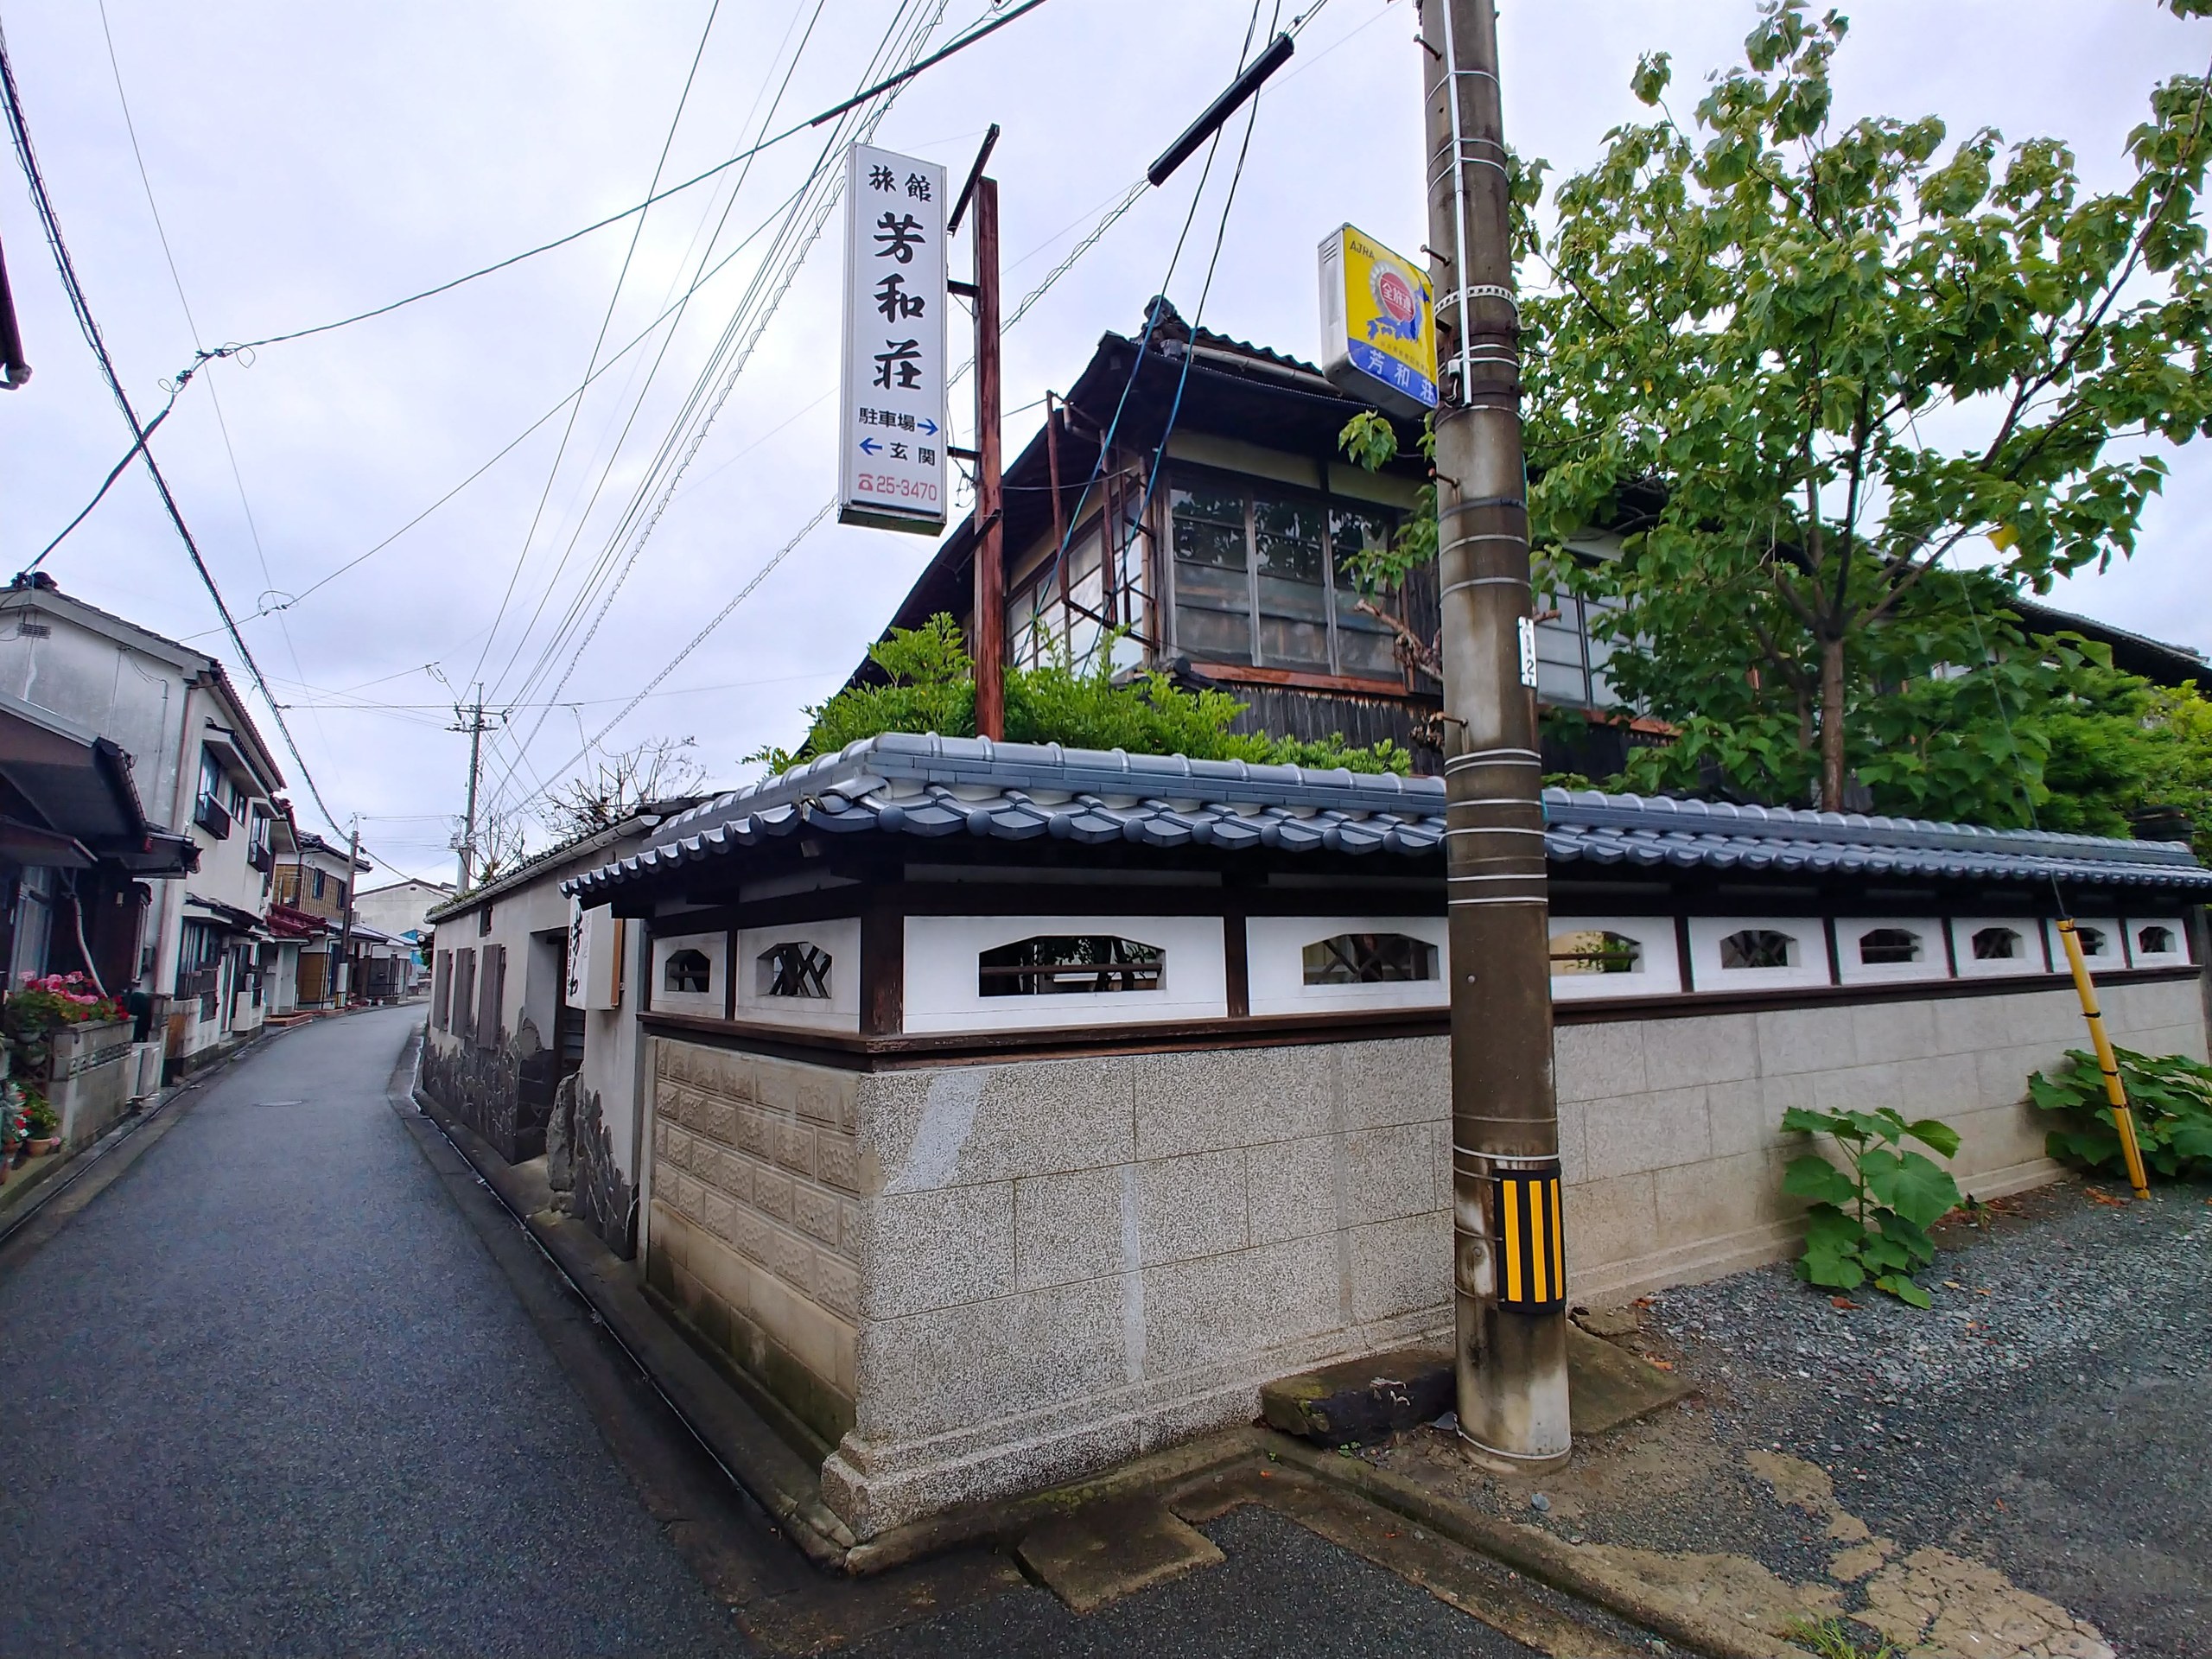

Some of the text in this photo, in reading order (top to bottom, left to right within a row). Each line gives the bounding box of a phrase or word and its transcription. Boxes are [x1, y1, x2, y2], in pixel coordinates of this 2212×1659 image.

[868, 164, 931, 202] 旅館
[873, 211, 925, 391] 芳和荘
[1368, 349, 1435, 404] 芳和荘
[858, 407, 915, 432] 駐車場
[890, 442, 935, 466] 玄関
[876, 475, 937, 501] 25-3470
